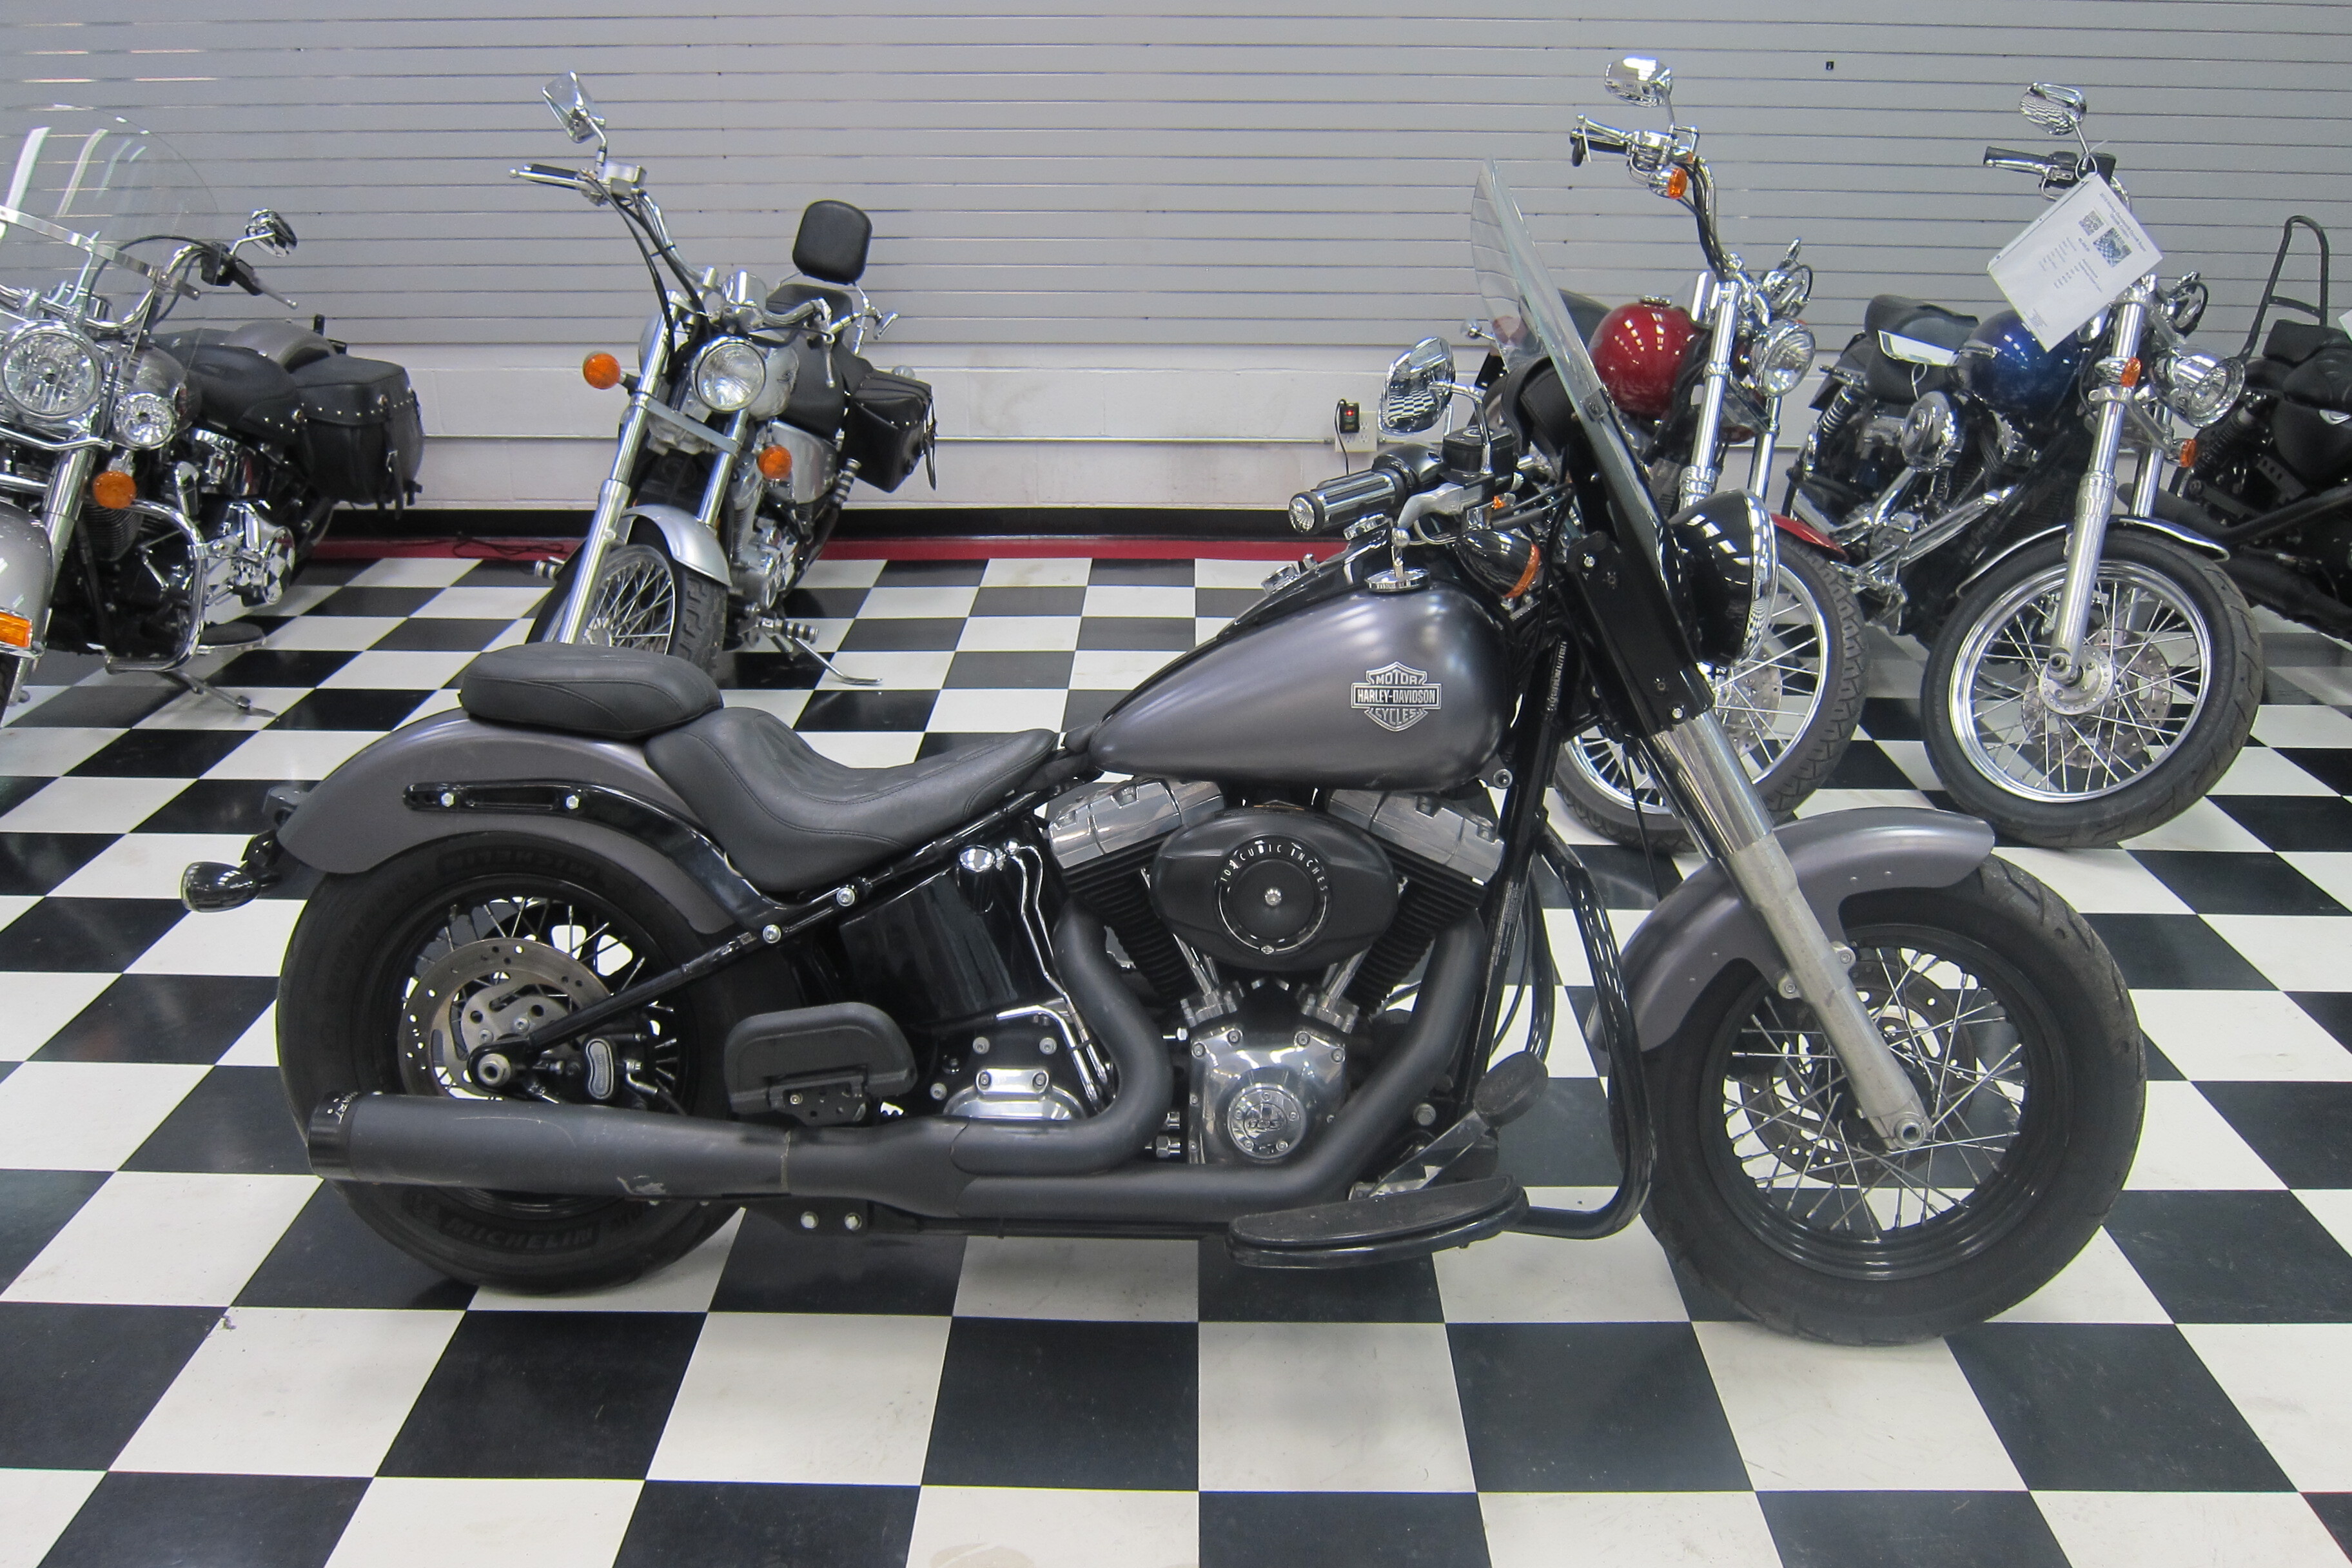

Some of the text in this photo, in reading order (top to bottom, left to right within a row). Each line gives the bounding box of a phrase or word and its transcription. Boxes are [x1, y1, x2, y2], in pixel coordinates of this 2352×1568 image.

[1376, 669, 1417, 685] MOTOR
[1357, 689, 1435, 704] HARLEY-DAVIDSON
[1375, 708, 1418, 725] CYCLES
[1239, 844, 1282, 861] CUBIC
[1290, 848, 1328, 891] INCHES
[444, 1217, 594, 1250] MICHELIN
